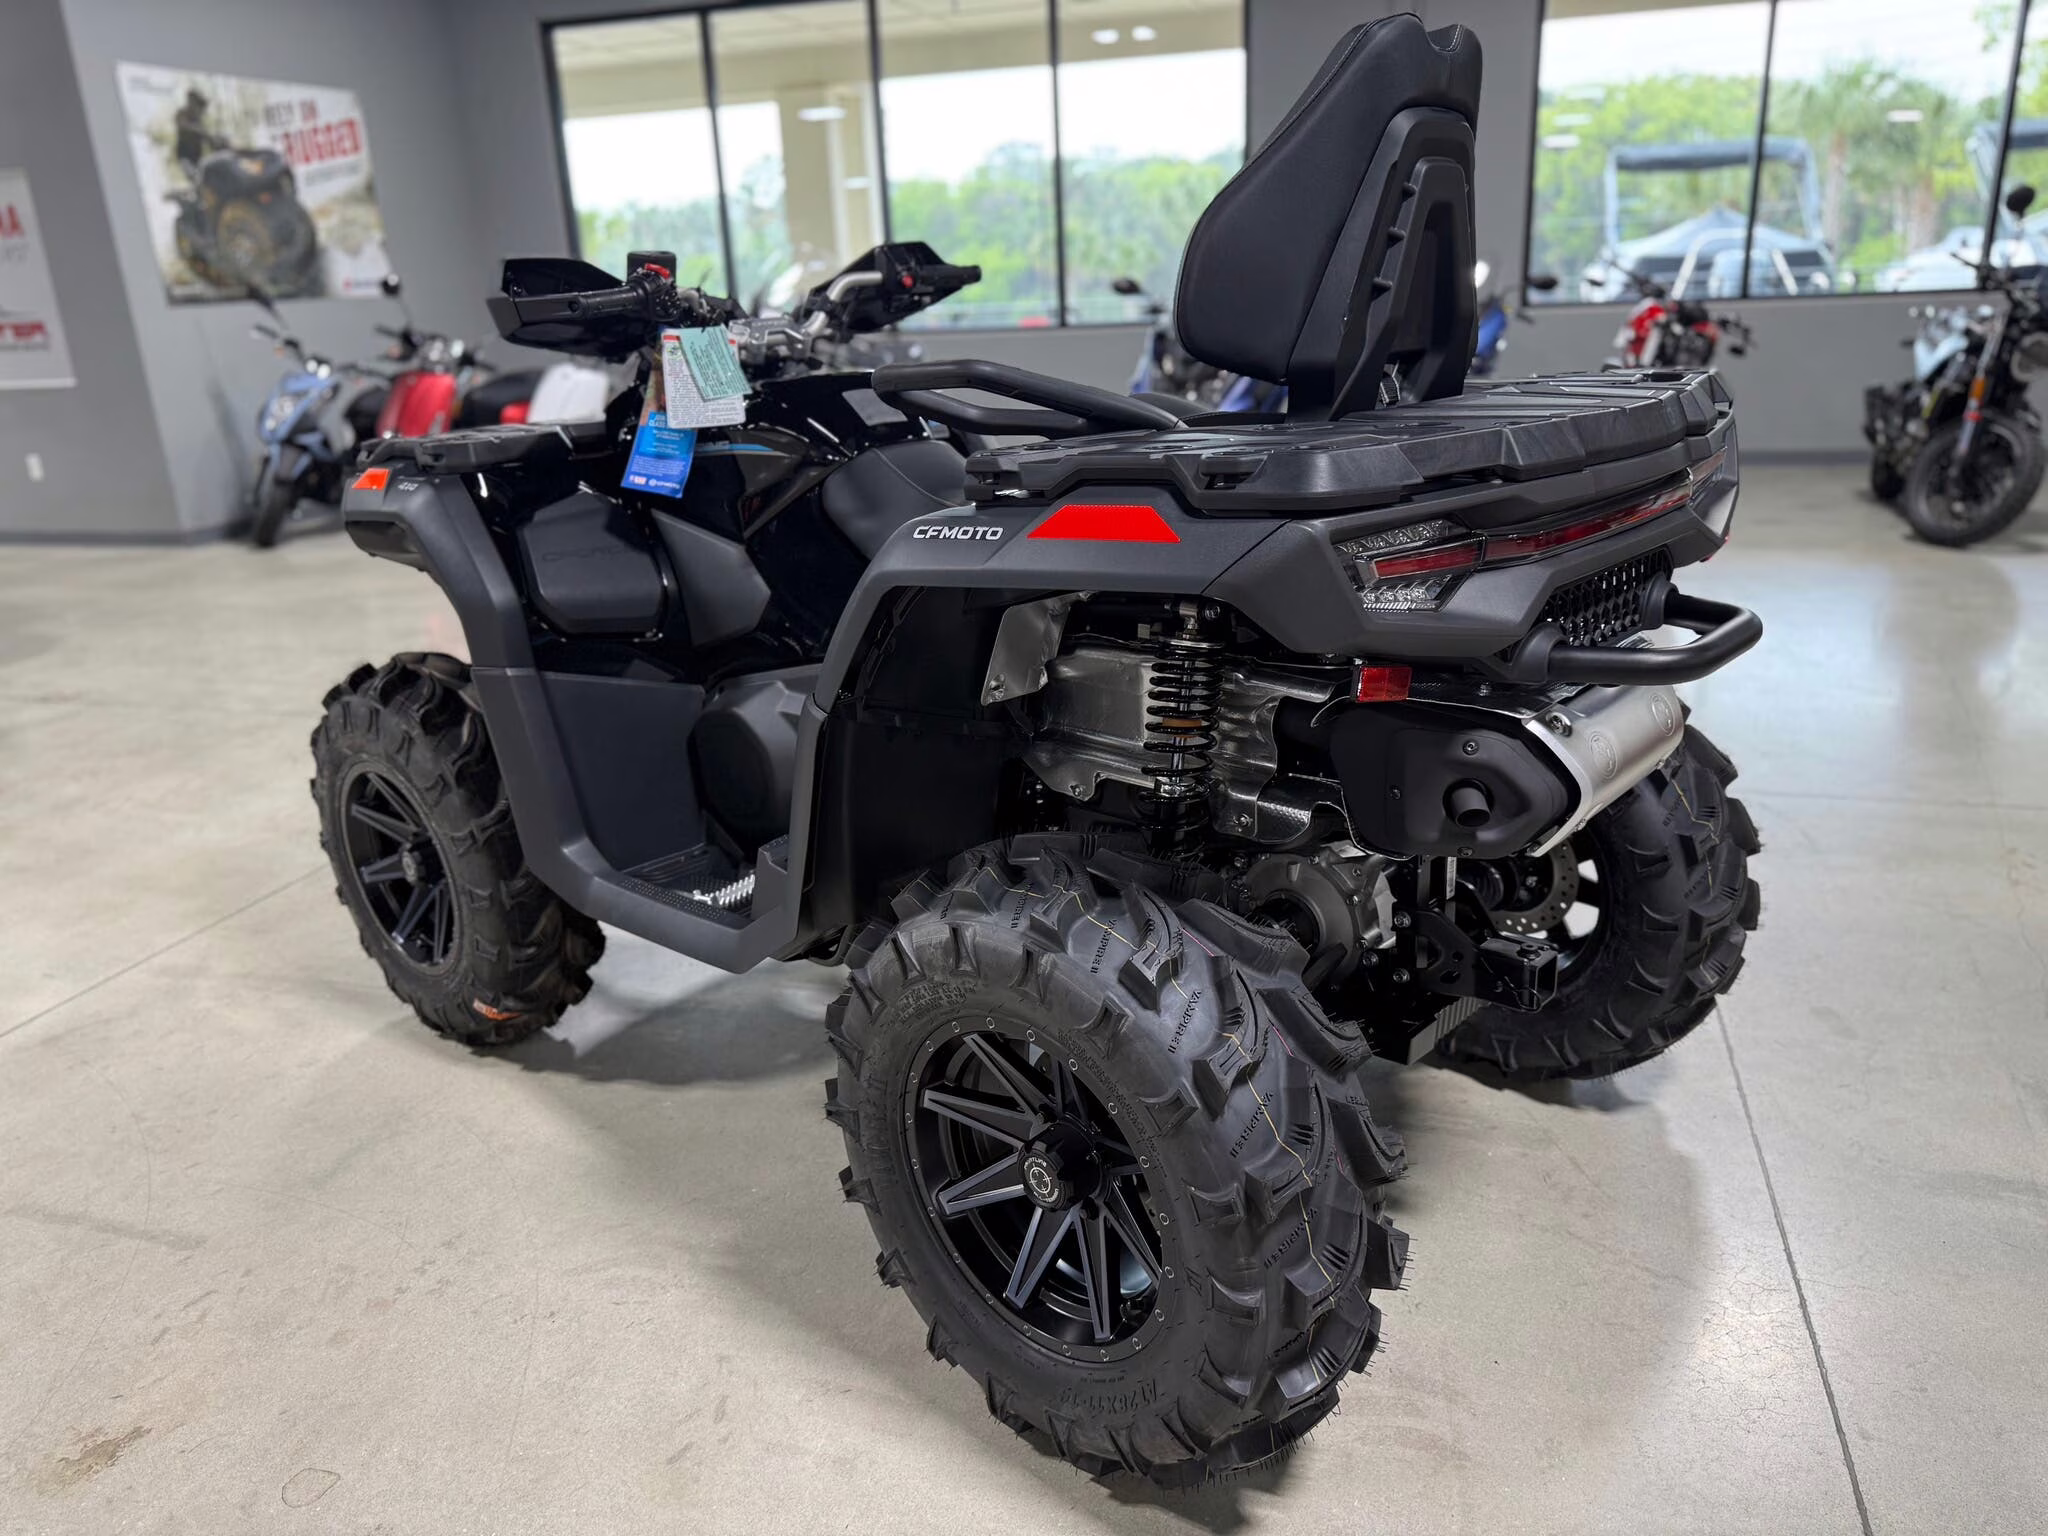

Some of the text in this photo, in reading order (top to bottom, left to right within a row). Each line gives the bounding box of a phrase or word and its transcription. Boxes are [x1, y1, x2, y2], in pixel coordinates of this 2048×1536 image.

[913, 526, 1004, 540] CFMOTO
[1169, 990, 1202, 1046] VAMPIRE
[1234, 1091, 1274, 1150] VAMPIRE
